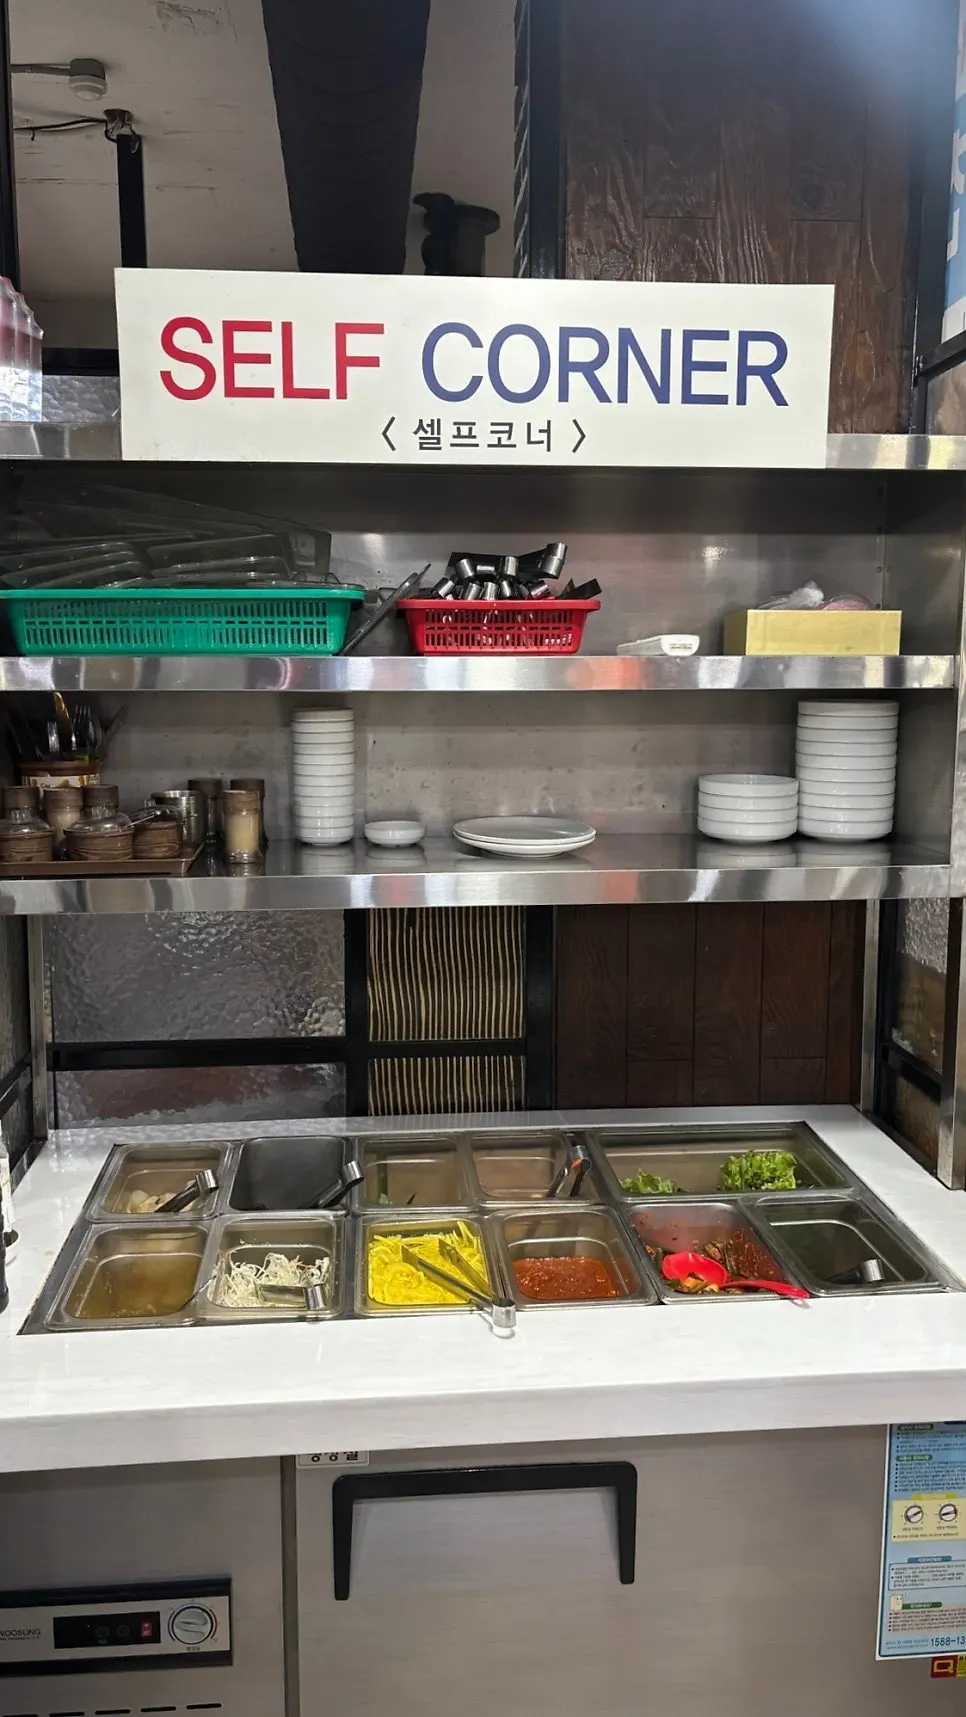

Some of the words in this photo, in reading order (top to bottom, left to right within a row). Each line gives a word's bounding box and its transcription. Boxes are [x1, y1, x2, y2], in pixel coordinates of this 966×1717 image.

[159, 316, 385, 401] SELF
[421, 321, 789, 407] CORNER
[412, 418, 552, 452] 셀프코너
